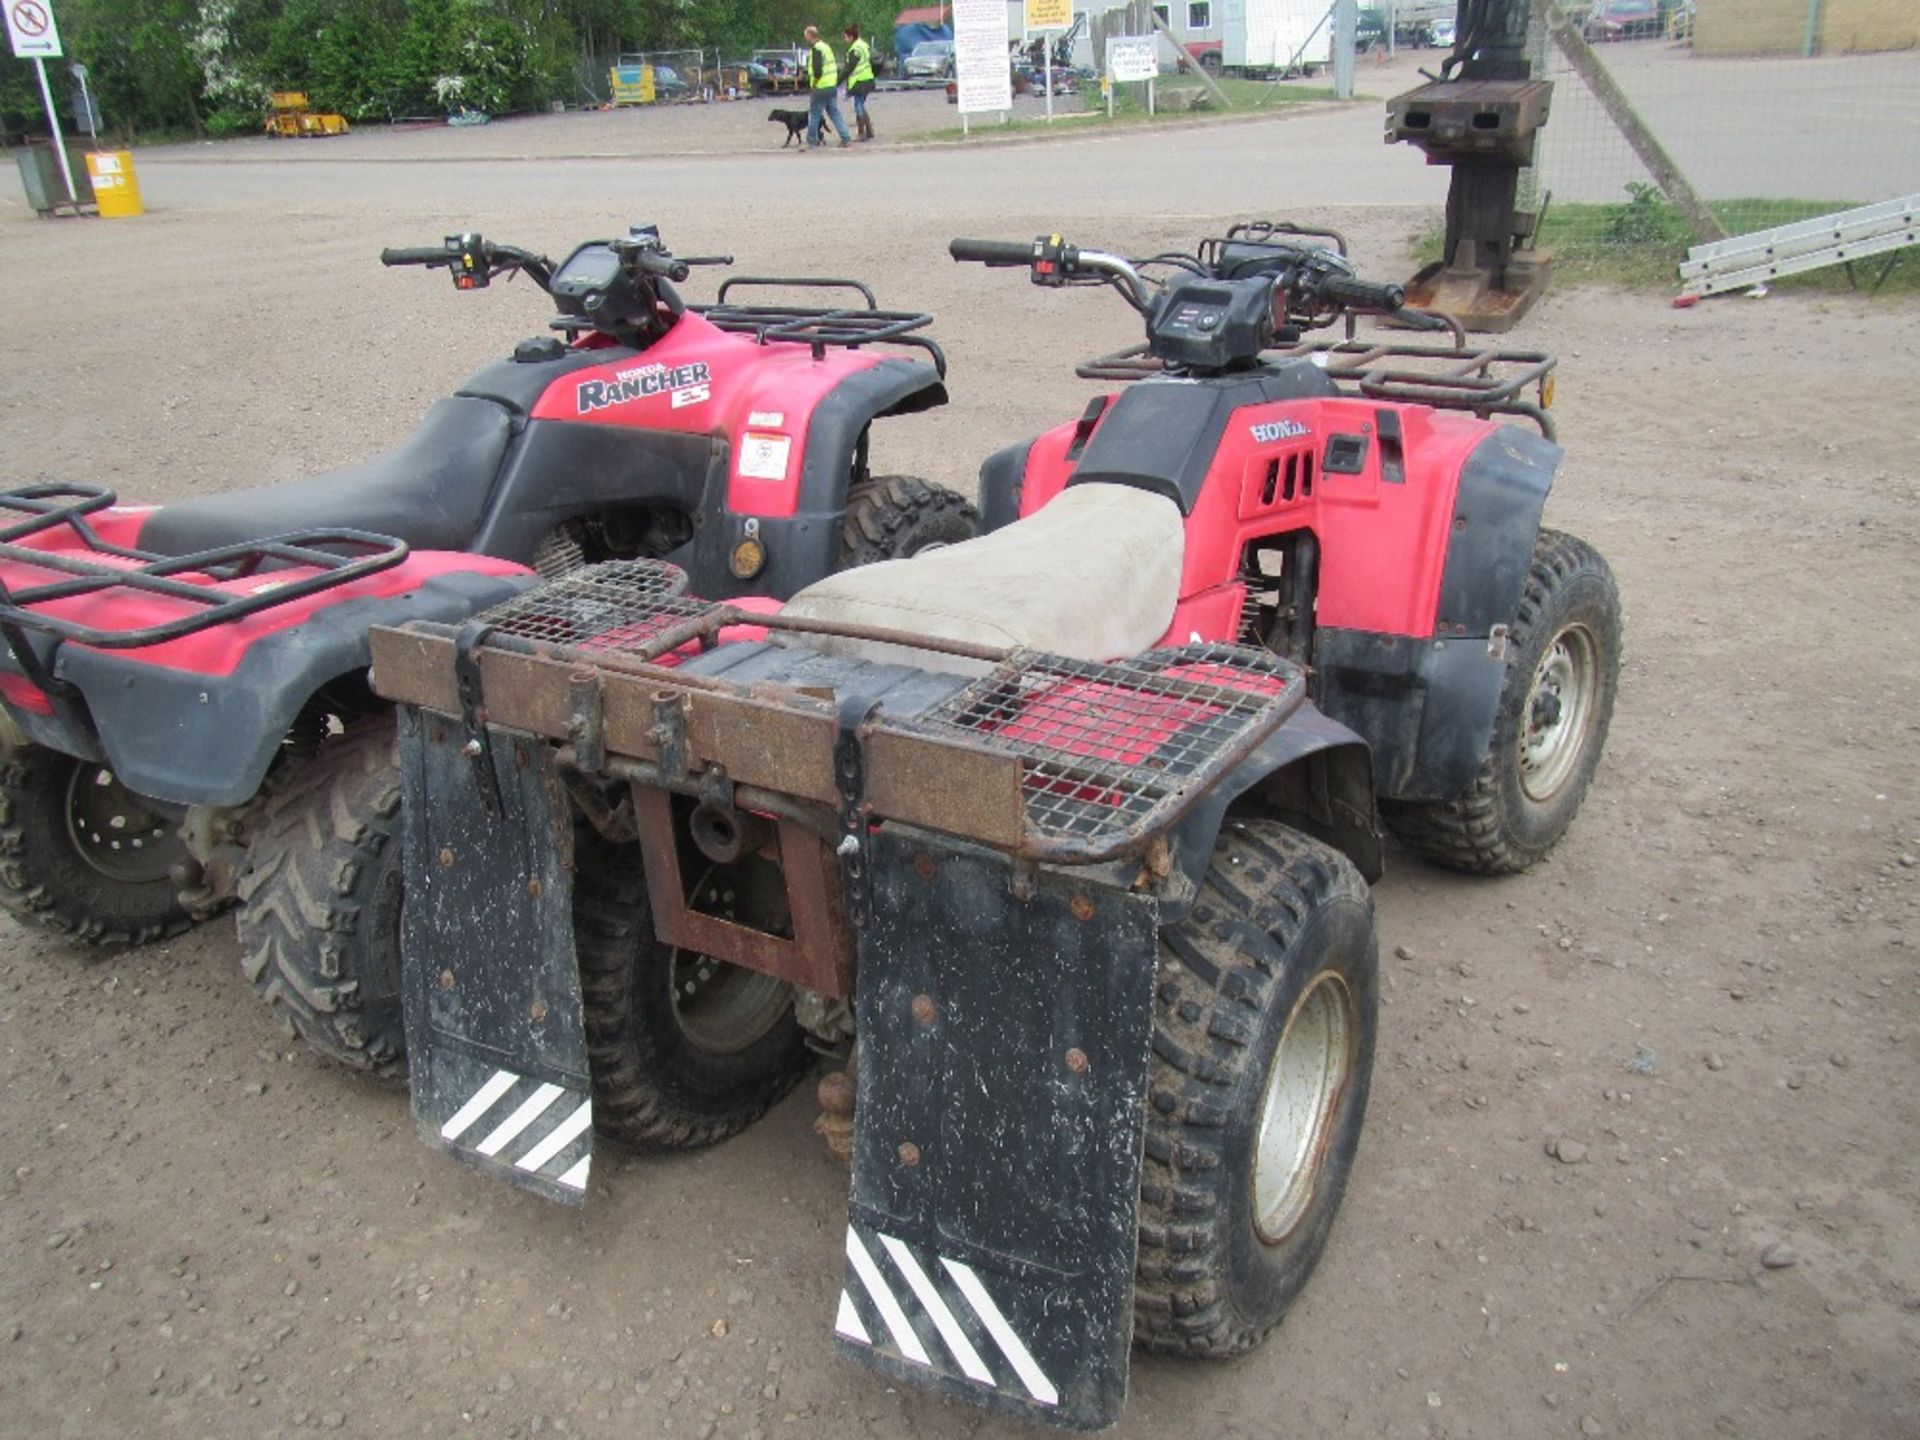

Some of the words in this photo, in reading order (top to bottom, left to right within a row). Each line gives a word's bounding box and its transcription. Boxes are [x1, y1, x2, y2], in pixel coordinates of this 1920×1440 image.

[616, 362, 666, 381] HONDA
[578, 362, 711, 414] RANCHER
[1250, 420, 1311, 442] HON
